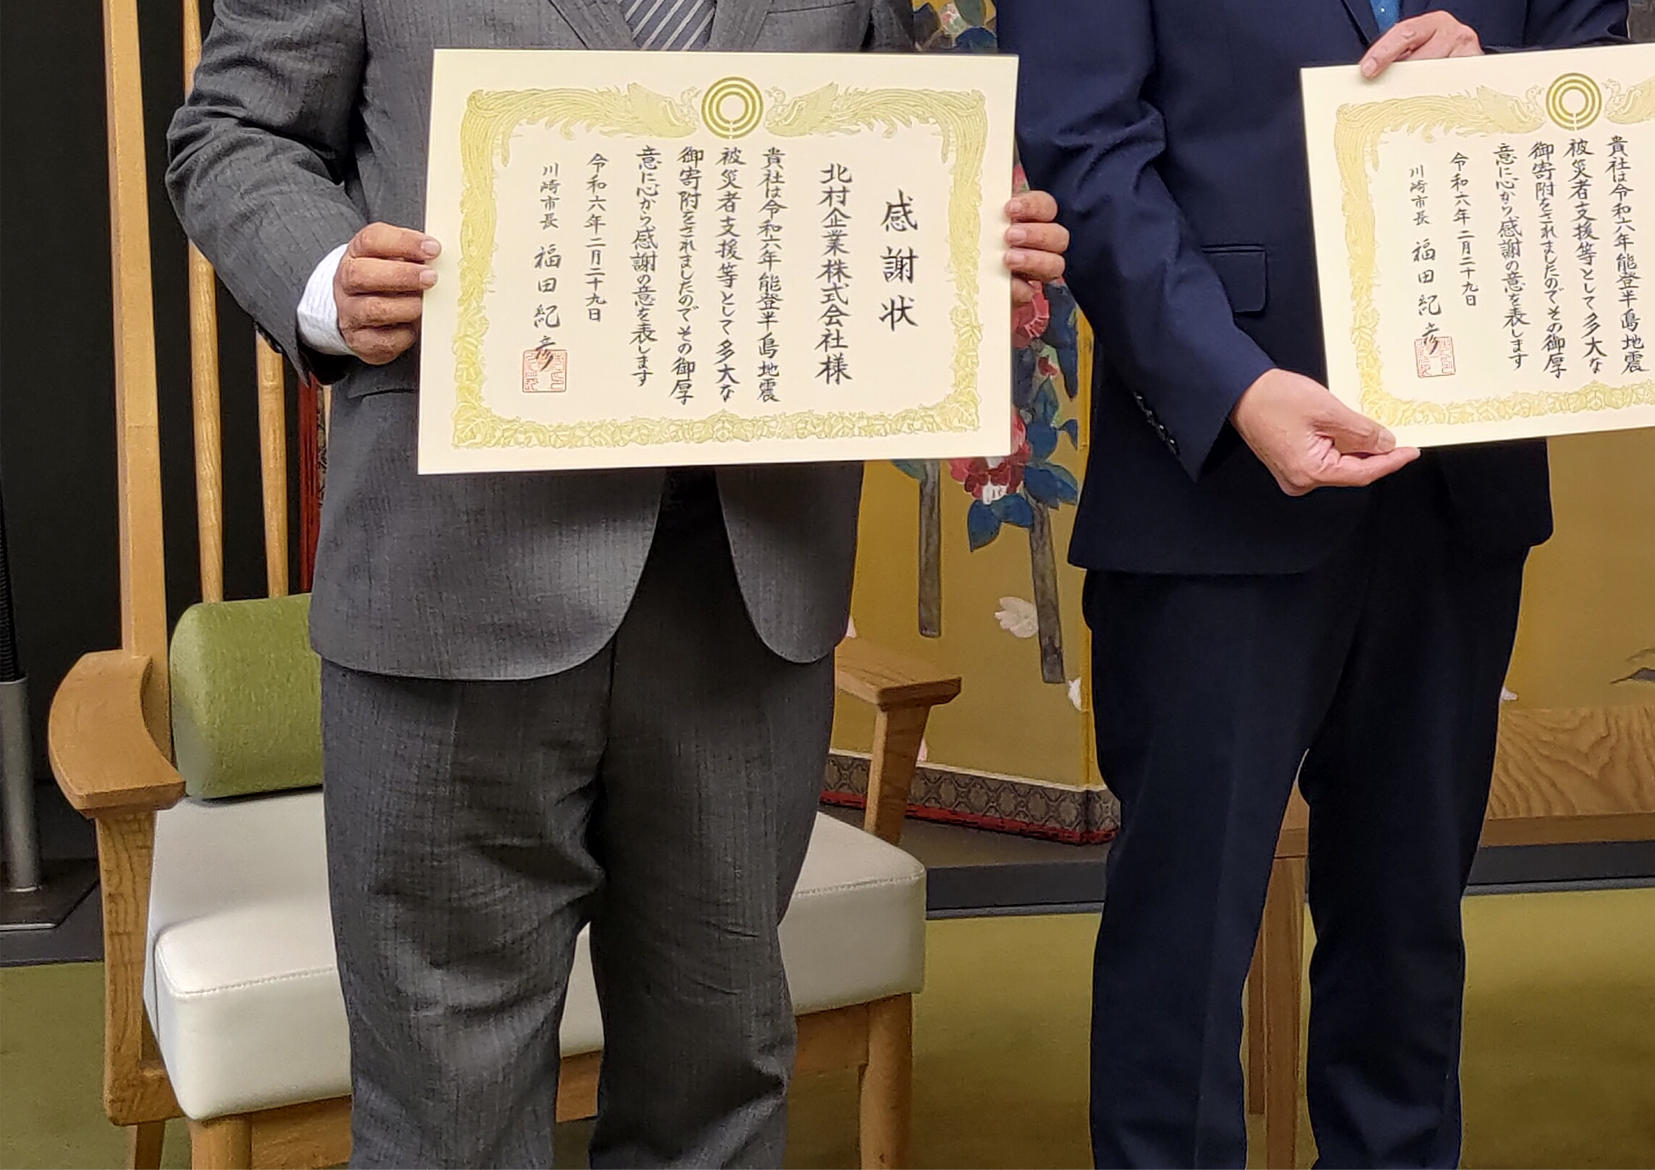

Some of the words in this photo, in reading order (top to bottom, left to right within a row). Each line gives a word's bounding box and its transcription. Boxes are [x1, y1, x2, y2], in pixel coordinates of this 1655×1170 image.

[584, 152, 608, 322] 令和六年二月二十九日
[814, 163, 853, 386] 北村企業株式会社様
[878, 189, 919, 332] 感謝状
[1450, 151, 1479, 307] 令和六年二月二十九日
